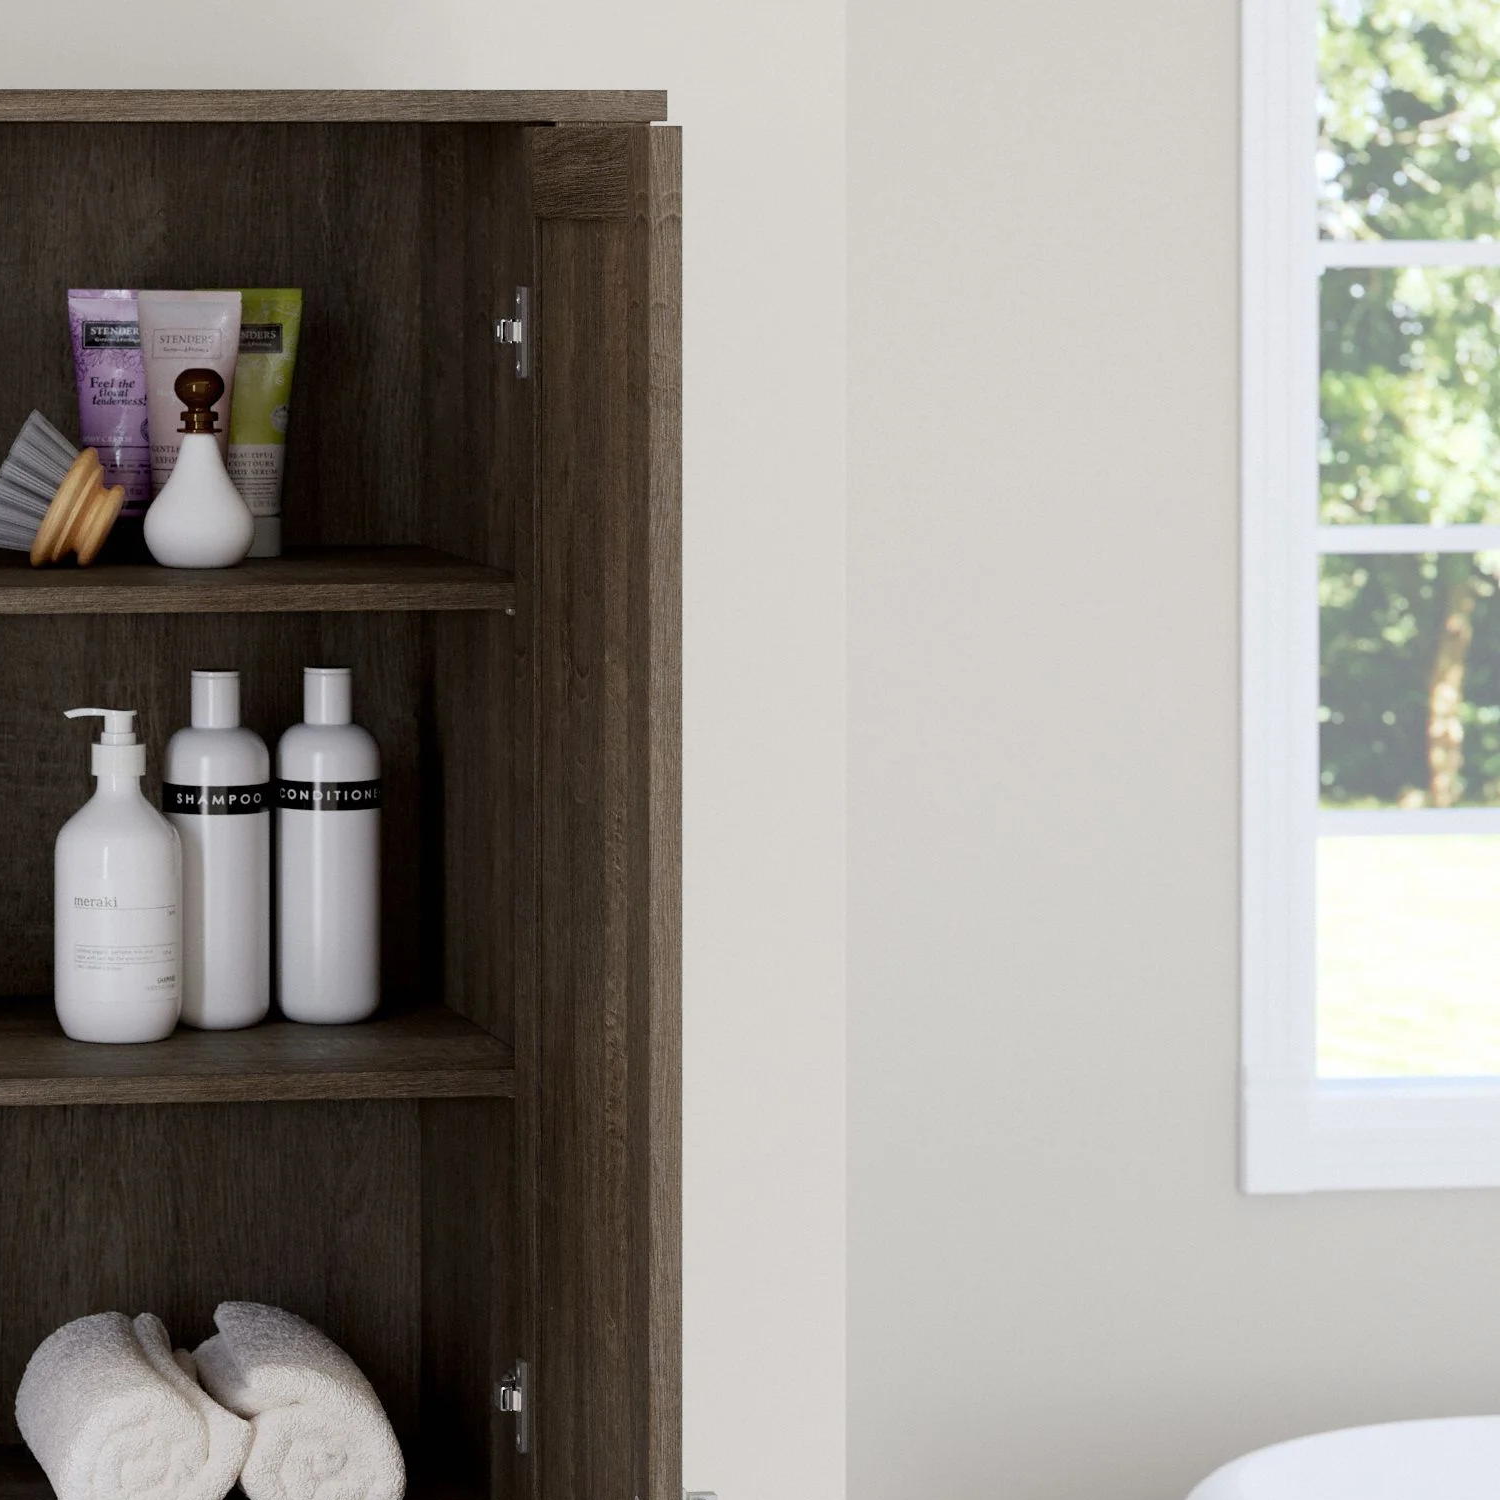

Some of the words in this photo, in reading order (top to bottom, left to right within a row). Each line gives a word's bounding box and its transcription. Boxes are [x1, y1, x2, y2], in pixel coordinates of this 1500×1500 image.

[90, 327, 139, 335] STENDER
[240, 331, 276, 339] NDERS
[159, 335, 214, 344] STENDERS
[90, 377, 114, 388] Feel
[118, 380, 135, 388] the
[92, 395, 147, 406] tenderness!
[176, 793, 262, 805] SHAMPOO
[279, 787, 381, 802] CONDITIONE
[74, 896, 118, 908] meraki
